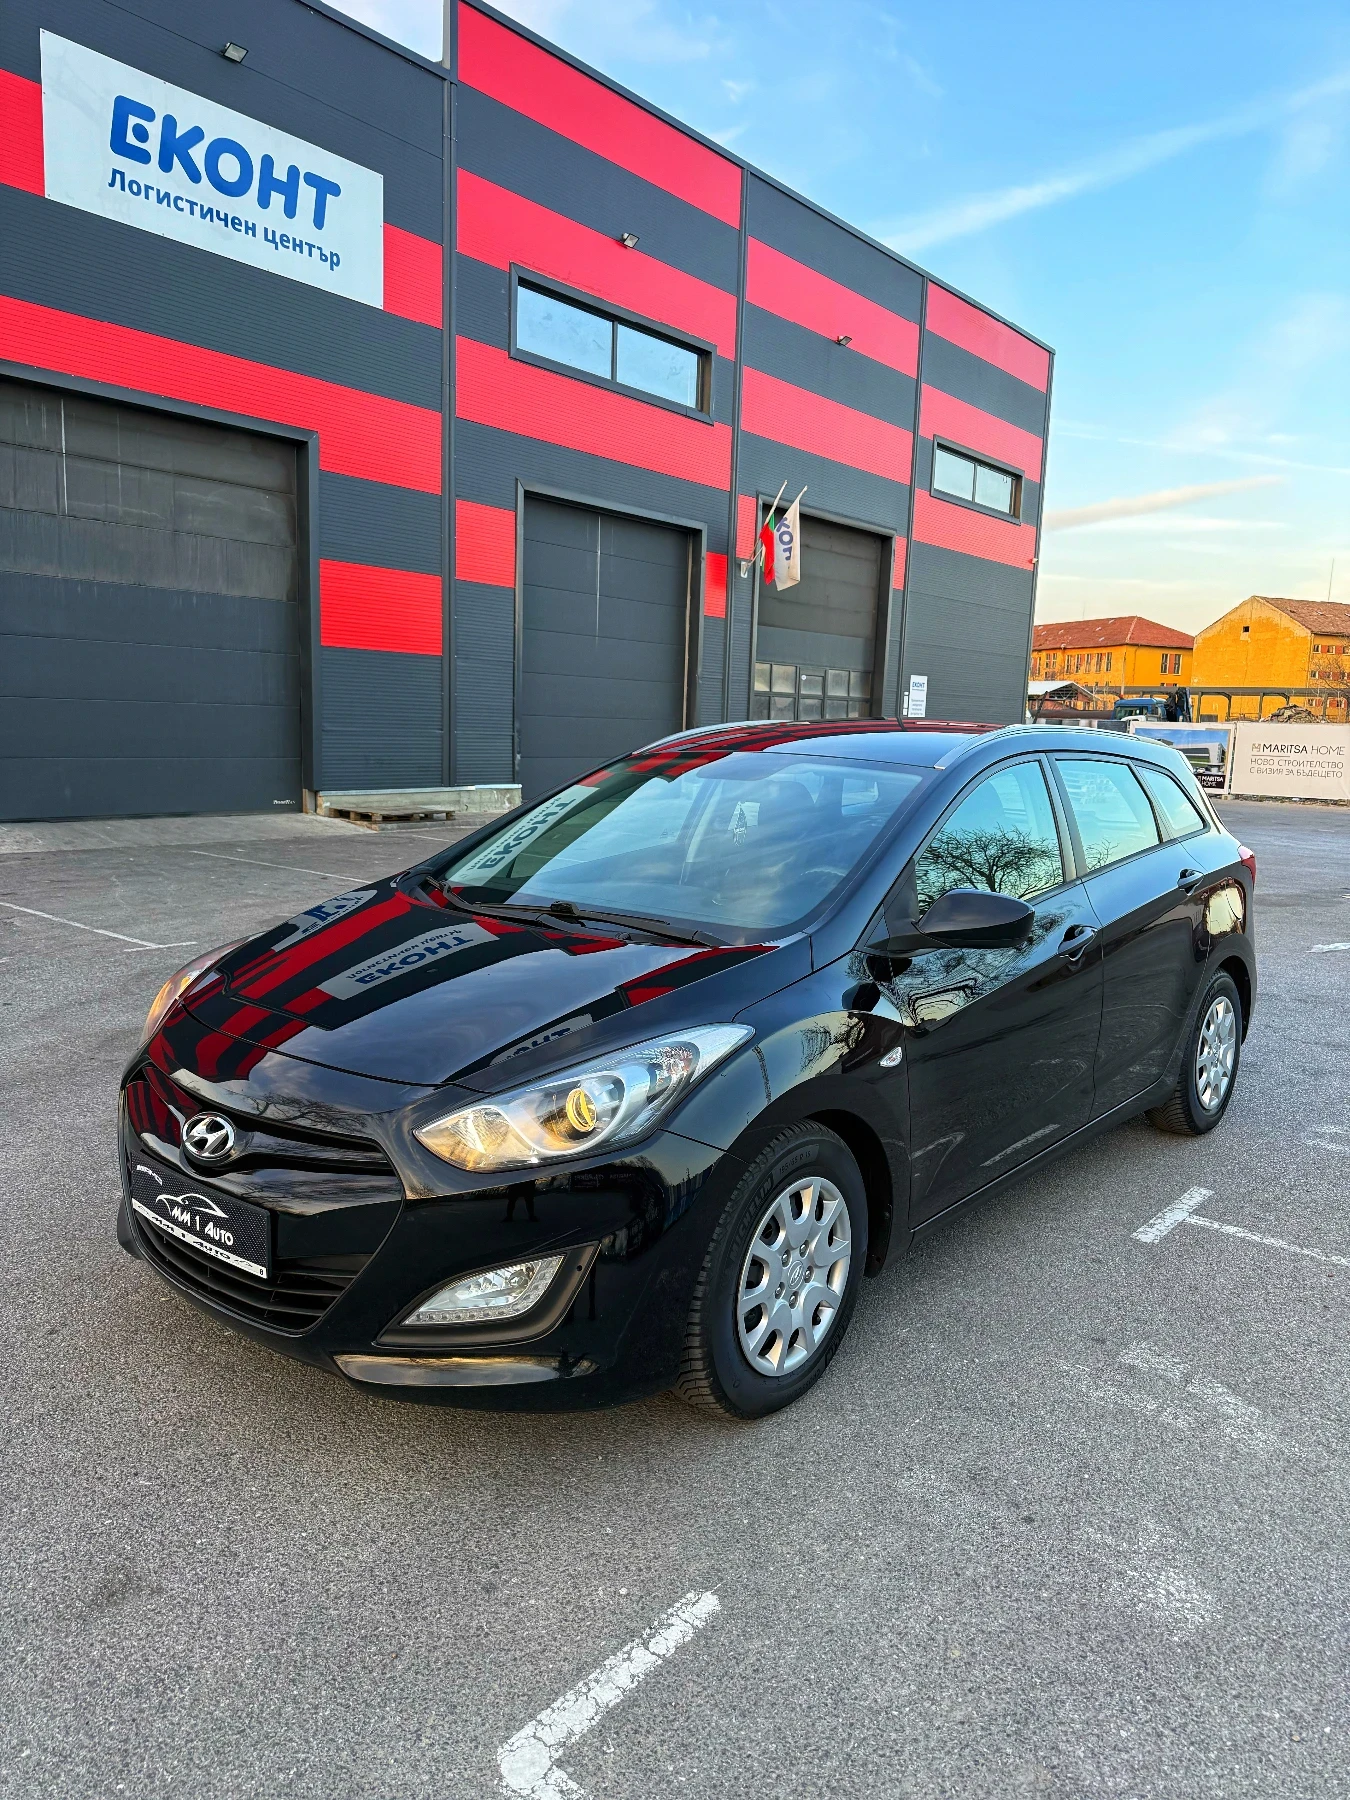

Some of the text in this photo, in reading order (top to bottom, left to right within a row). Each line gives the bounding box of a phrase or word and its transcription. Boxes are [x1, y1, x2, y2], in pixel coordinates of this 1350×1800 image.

[109, 94, 342, 231] ЕКОНТ
[107, 167, 342, 272] Логистичен център
[1263, 744, 1345, 755] MARITSA HOME
[1250, 757, 1344, 770] НОВО СТРОИТЕЛСТВО
[1257, 767, 1284, 775] ВИЗИЯ
[1285, 768, 1295, 776] ЗА
[1296, 769, 1343, 779] БЪДЕЩЕТО
[171, 1205, 191, 1227] MM
